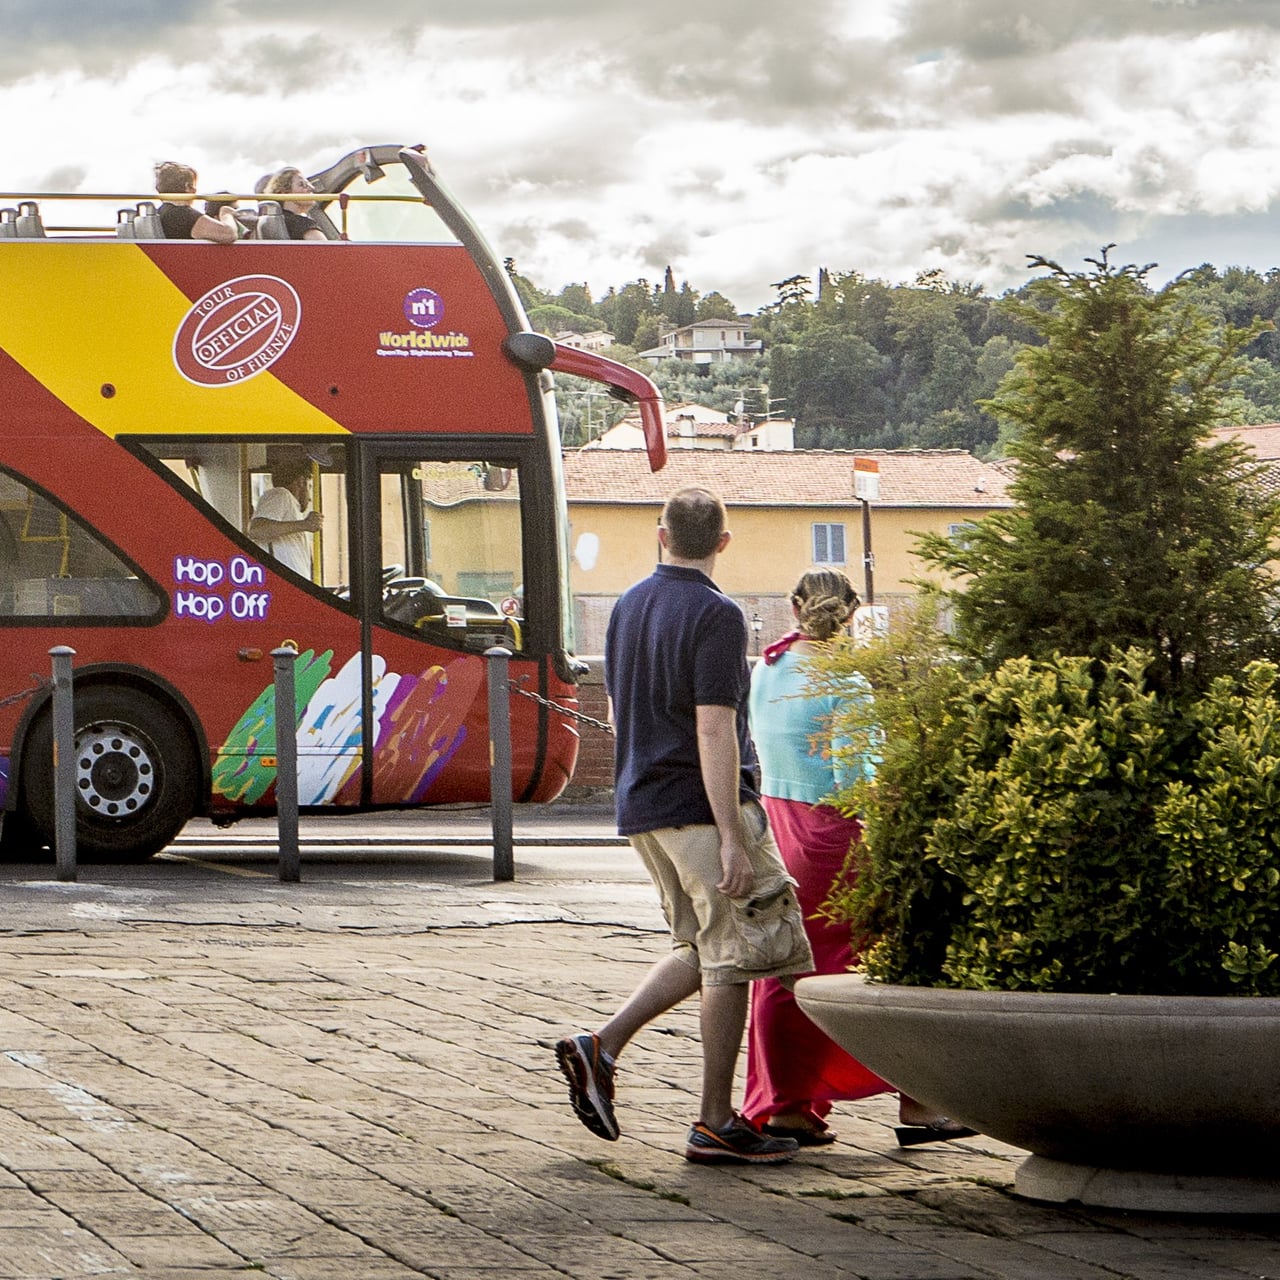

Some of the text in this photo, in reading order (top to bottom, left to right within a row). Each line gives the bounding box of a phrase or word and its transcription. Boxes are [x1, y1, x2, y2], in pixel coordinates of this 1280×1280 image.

[193, 286, 236, 318] TOUR
[197, 300, 278, 362] OFFICIAL
[379, 330, 469, 349] Worldwide
[225, 321, 295, 382] OF FIRENZE
[176, 556, 263, 587] Hop On
[176, 590, 270, 621] Hop Off
